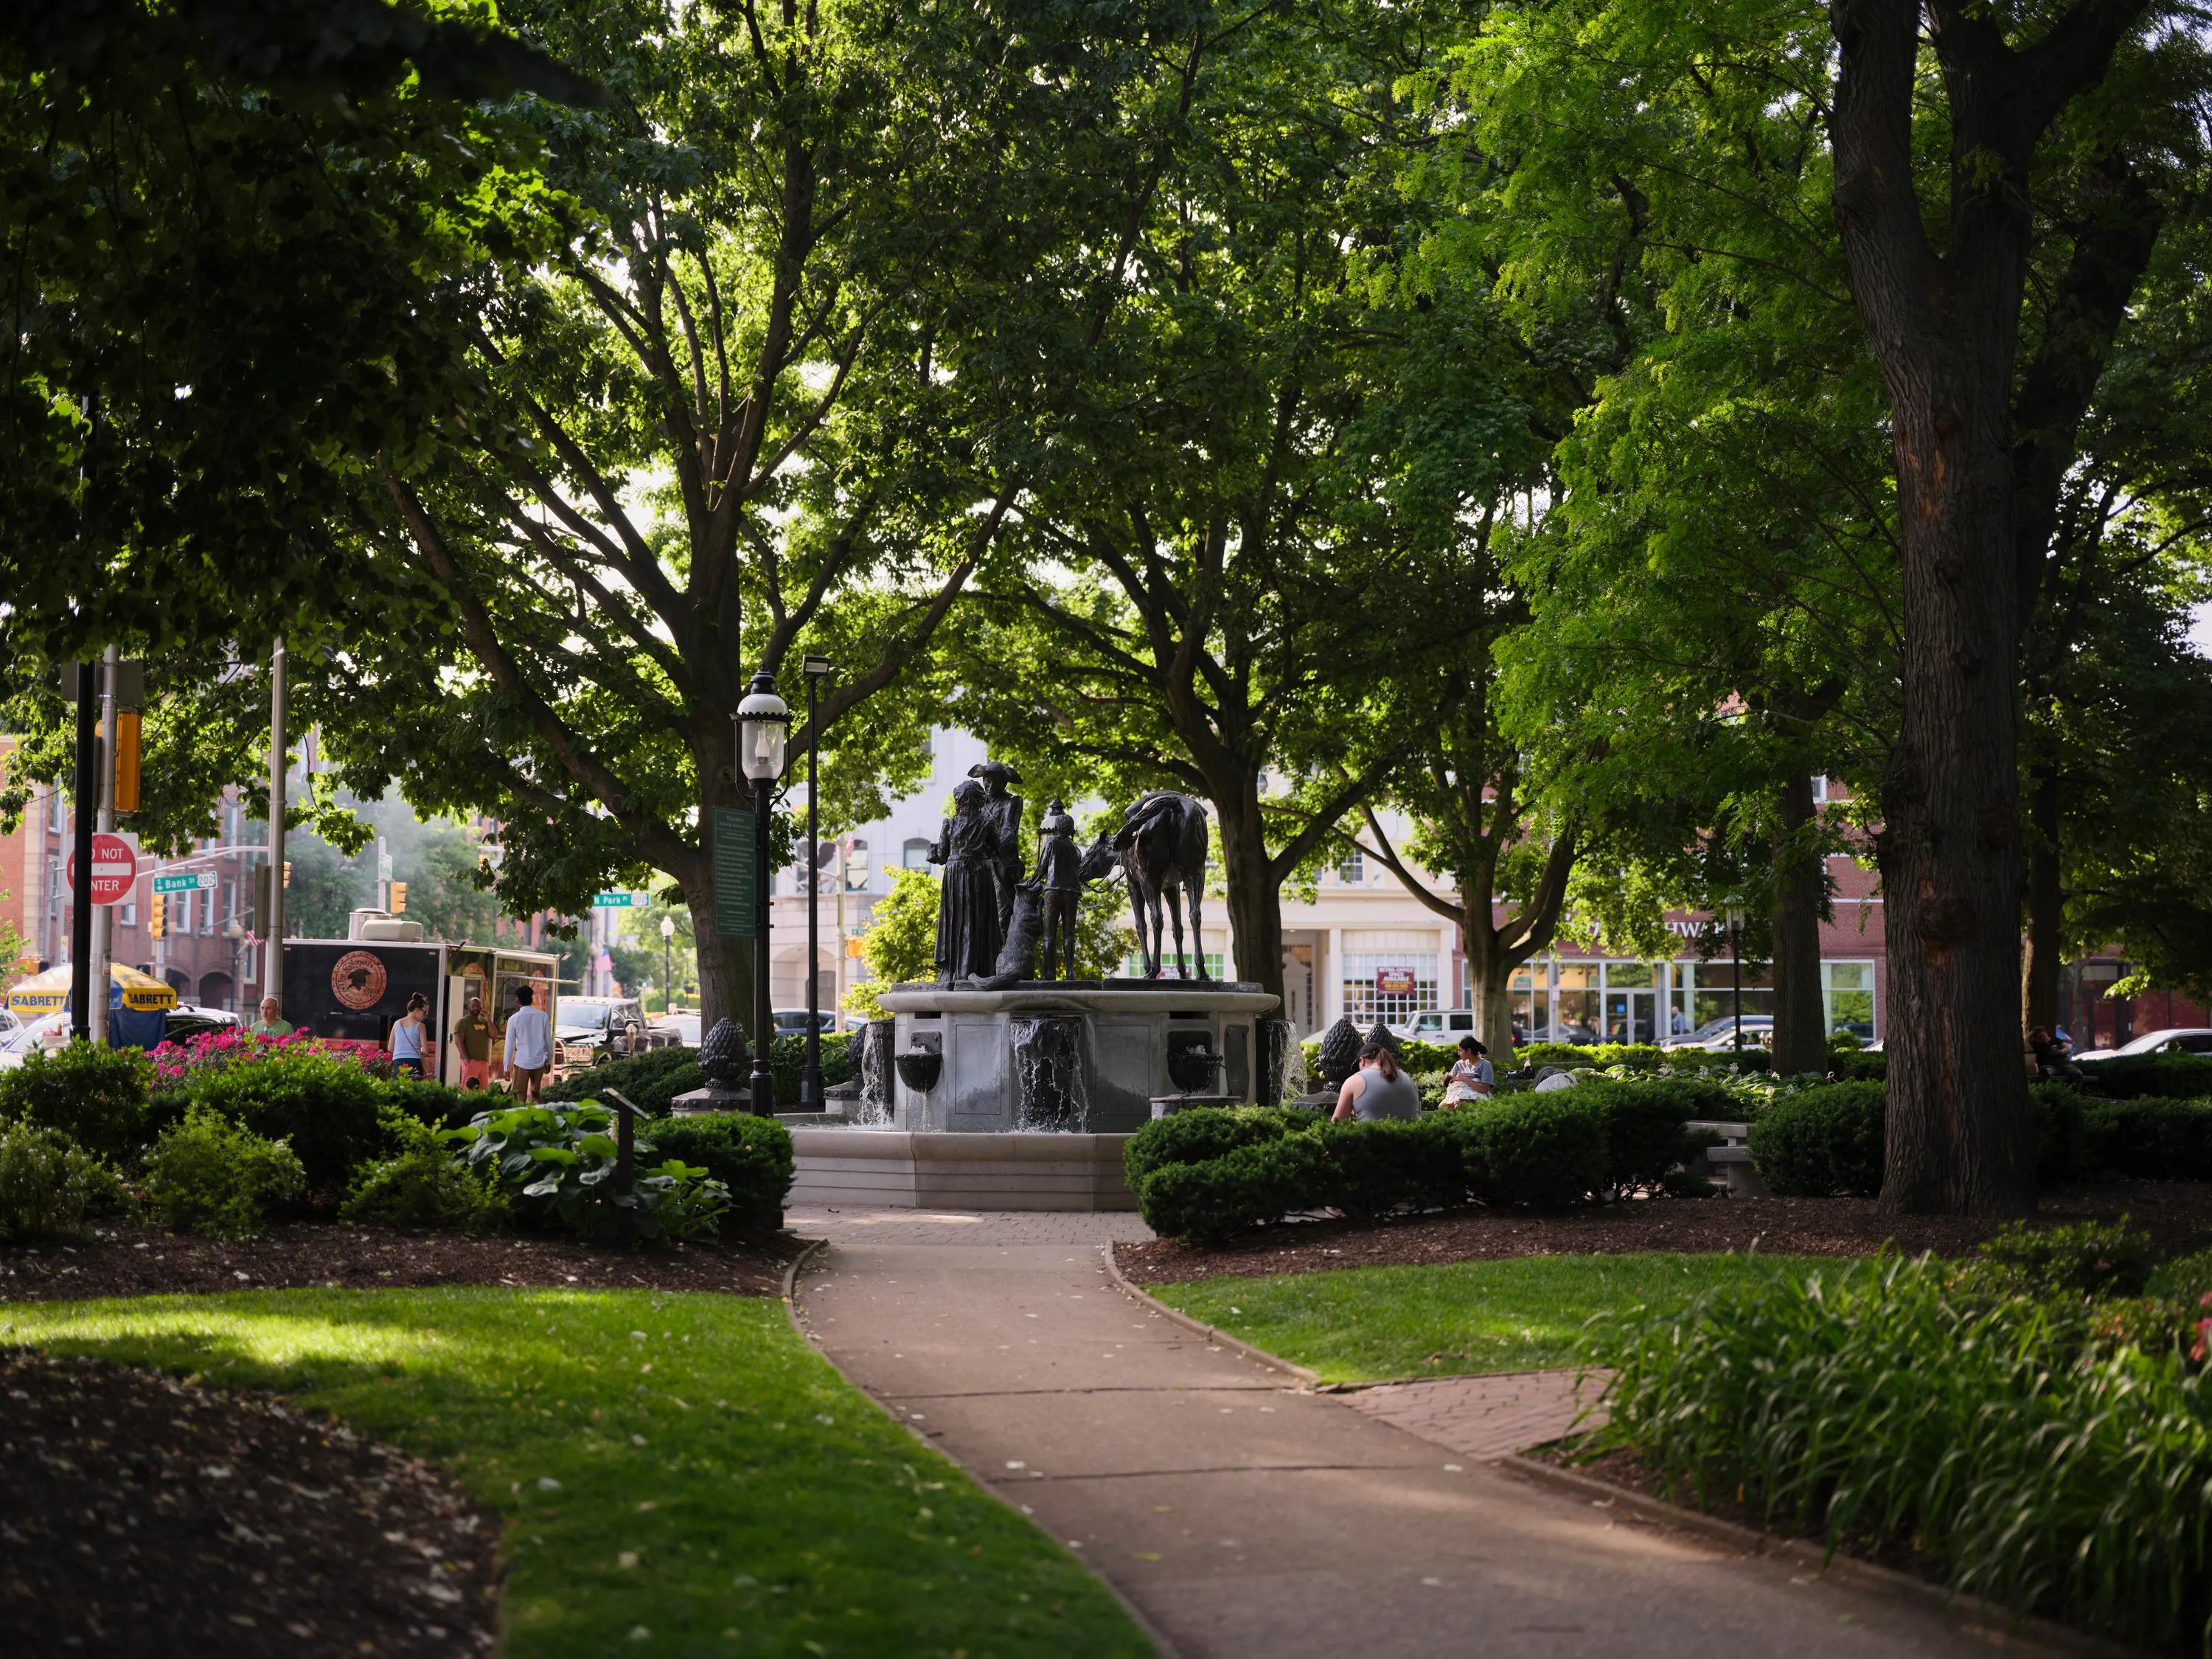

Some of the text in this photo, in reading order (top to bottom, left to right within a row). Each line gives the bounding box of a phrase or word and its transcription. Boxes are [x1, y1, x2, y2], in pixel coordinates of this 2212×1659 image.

[102, 848, 123, 859] NOT
[91, 880, 119, 891] NTER
[165, 878, 187, 888] Bank
[198, 875, 214, 886] 202
[594, 896, 600, 904] N
[603, 896, 621, 904] Park
[11, 995, 65, 1006] SABRETT
[128, 994, 173, 1004] SABRETT
